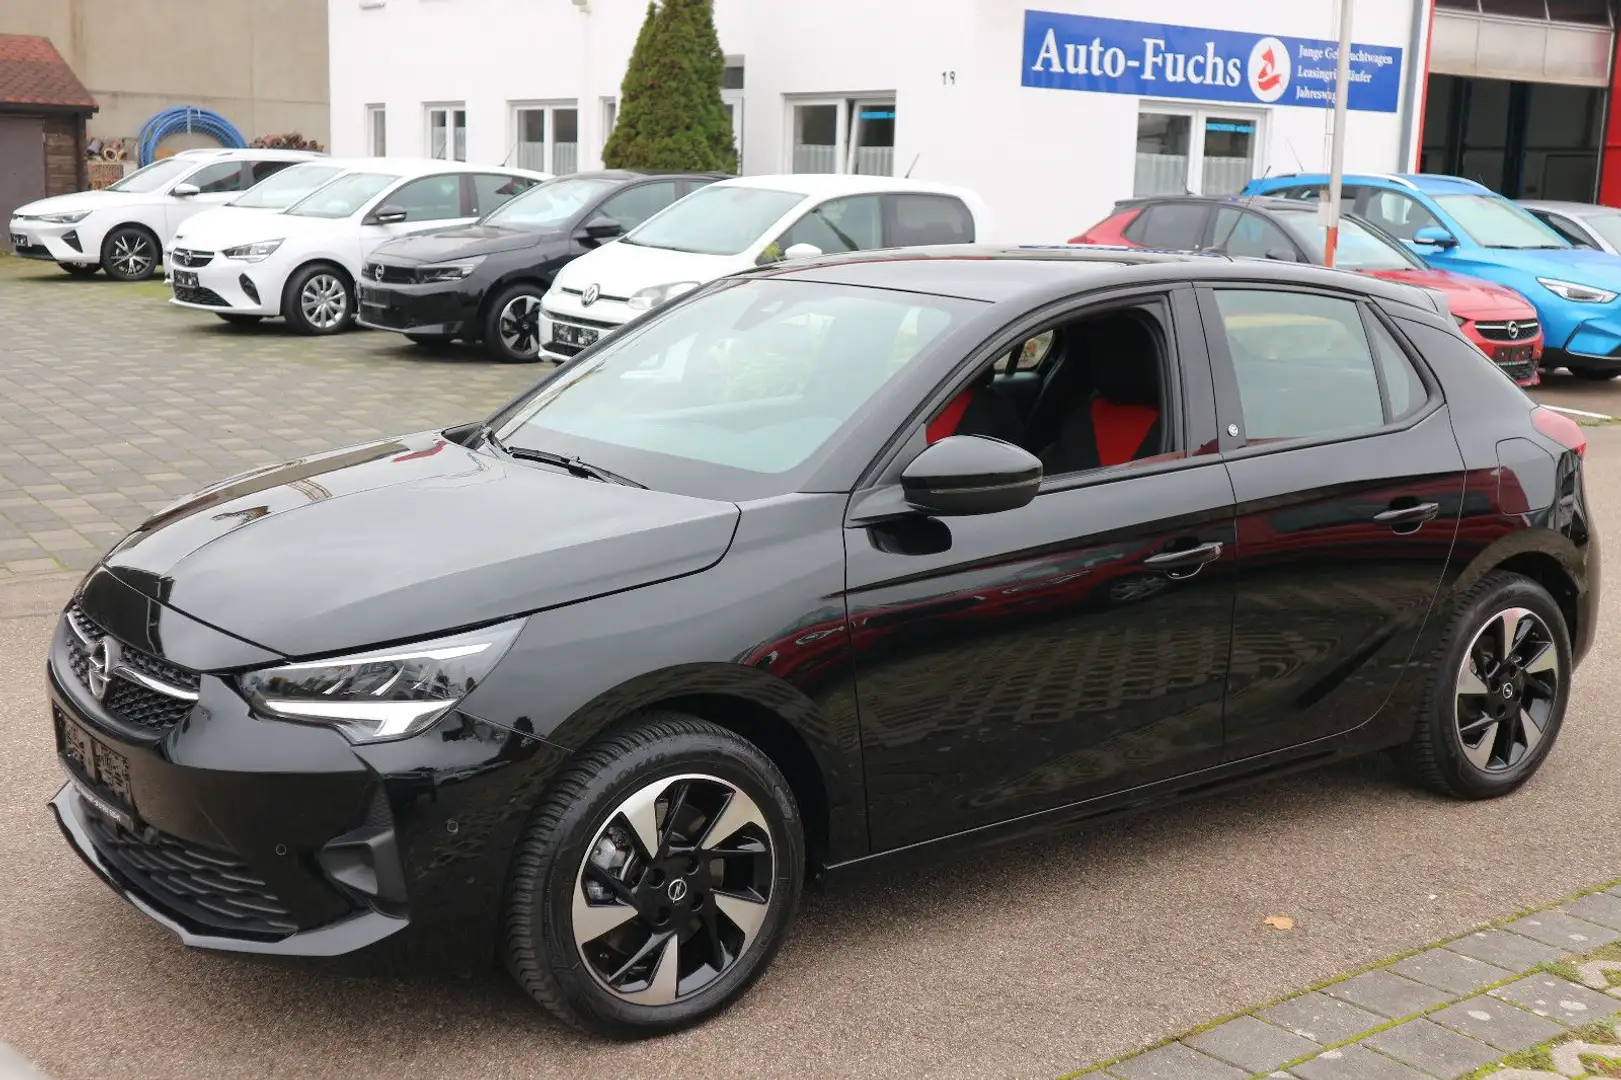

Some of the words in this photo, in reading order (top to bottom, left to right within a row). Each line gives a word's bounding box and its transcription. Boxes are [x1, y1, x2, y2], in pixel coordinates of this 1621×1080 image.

[1032, 28, 1241, 87] Auto-Fuchs
[1299, 44, 1323, 62] Junge
[1325, 47, 1393, 67] Geuchtwagen
[942, 71, 956, 86] 19
